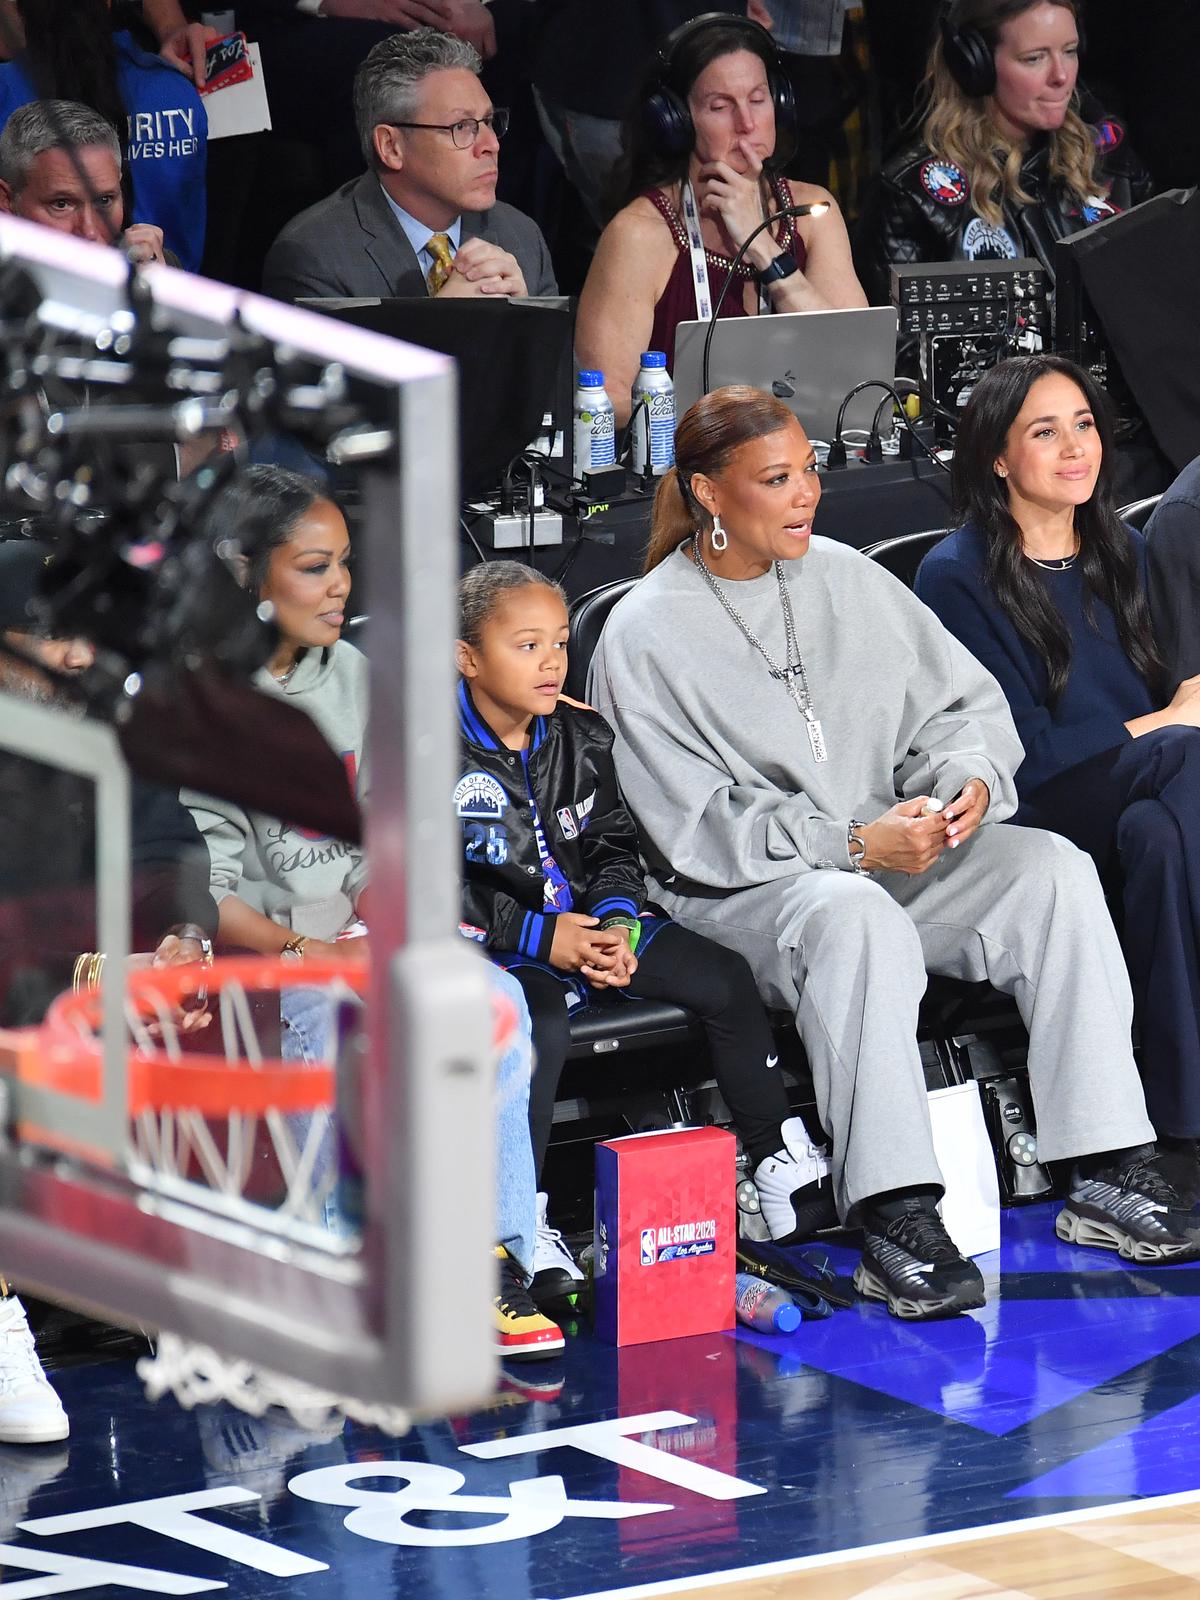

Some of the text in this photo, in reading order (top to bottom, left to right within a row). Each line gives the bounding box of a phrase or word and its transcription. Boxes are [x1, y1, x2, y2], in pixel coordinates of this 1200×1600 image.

[127, 108, 194, 142] RITY
[124, 142, 164, 161] IVES
[454, 784, 468, 801] CITY
[481, 776, 506, 803] ANGELS
[463, 823, 510, 866] 26
[695, 1219, 717, 1241] 2026
[675, 1241, 714, 1257] Los Angeles
